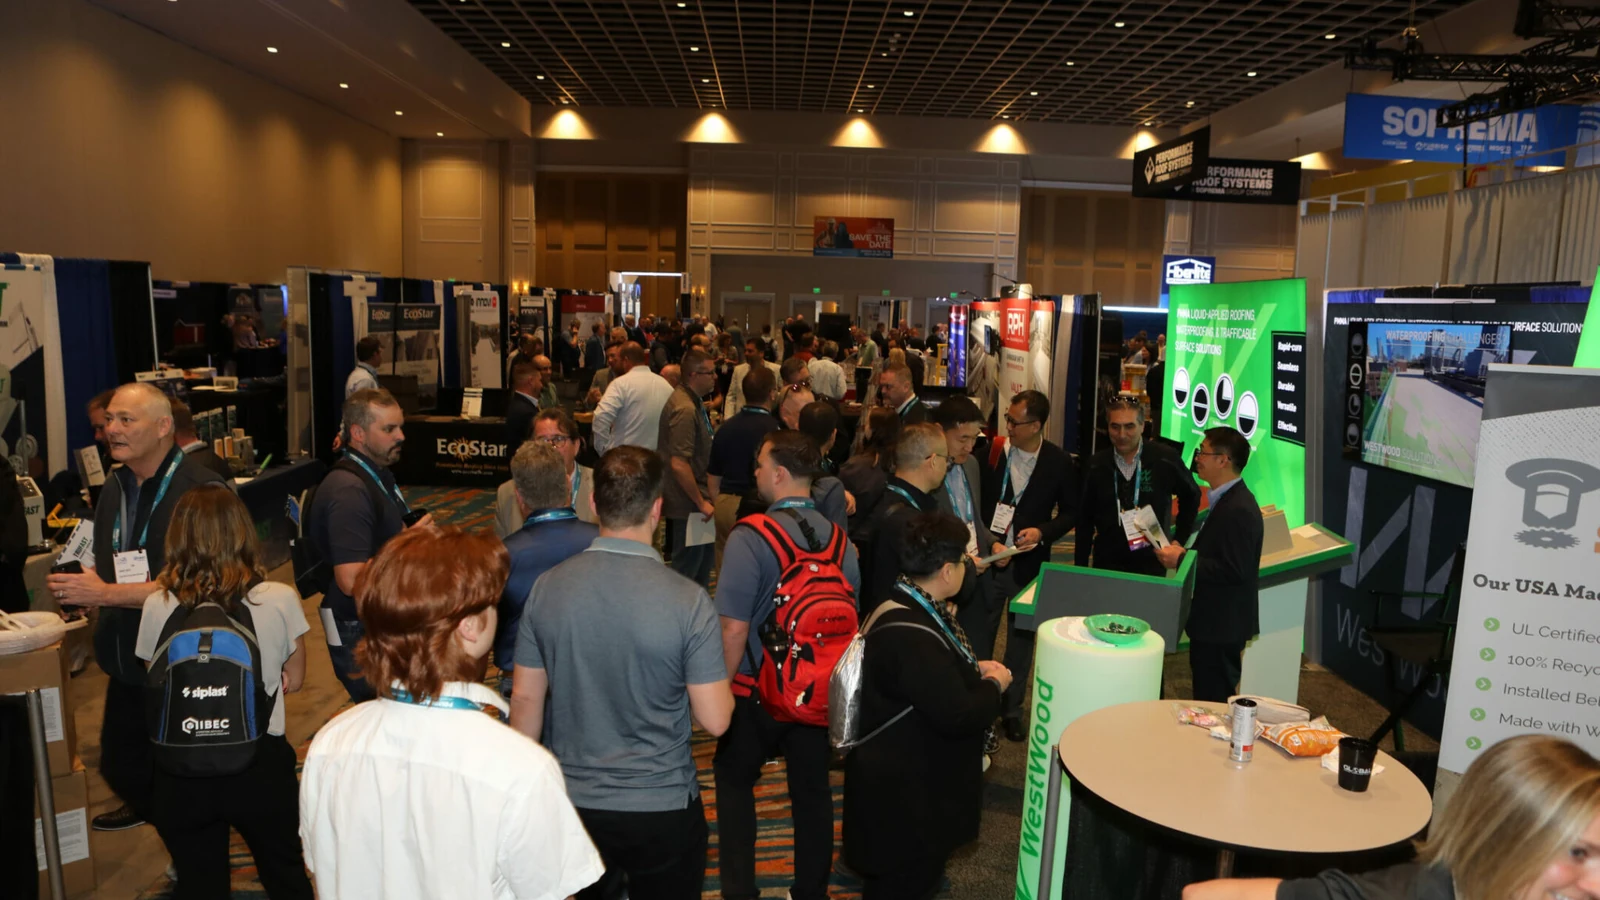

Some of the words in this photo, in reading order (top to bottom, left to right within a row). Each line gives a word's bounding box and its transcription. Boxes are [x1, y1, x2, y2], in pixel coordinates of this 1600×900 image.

[1155, 141, 1194, 164] PERFORMANCE
[1168, 153, 1193, 171] SYSTEMS
[1207, 166, 1274, 179] RFORMANCE
[1222, 178, 1273, 189] SYSTEMS
[1195, 187, 1225, 195] SOPREMA
[874, 234, 892, 242] THE
[868, 241, 891, 249] DATE
[371, 309, 391, 320] EcoStar
[403, 308, 434, 319] EcoStar
[1191, 308, 1230, 320] LIQUID-APPLIED
[1007, 313, 1025, 336] RPH
[1509, 322, 1541, 332] URFACE
[1541, 322, 1584, 333] SOLUTION
[1220, 327, 1257, 340] TRAFFICABLE
[1385, 330, 1446, 341] WATERPROOFING
[1175, 340, 1195, 352] SURFACE
[1195, 342, 1222, 355] SOLUTIONS
[1277, 341, 1303, 353] Rapid-cure
[1276, 361, 1299, 373] Seamless
[1277, 381, 1296, 393] Durable
[1276, 400, 1298, 413] Versatile
[1277, 420, 1298, 434] Effective
[436, 438, 508, 457] EcoStar
[1363, 441, 1401, 457] WESTWOOD
[1472, 573, 1511, 592] Our
[1515, 578, 1560, 597] USA
[1512, 622, 1534, 637] UL
[1507, 655, 1548, 669] 100%
[192, 685, 227, 700] siplast
[1503, 683, 1571, 703] Installed
[1575, 692, 1600, 707] Be
[199, 719, 230, 730] IBEC
[1499, 712, 1543, 729] Made
[1547, 721, 1581, 735] with
[1021, 676, 1054, 858] WestWood
